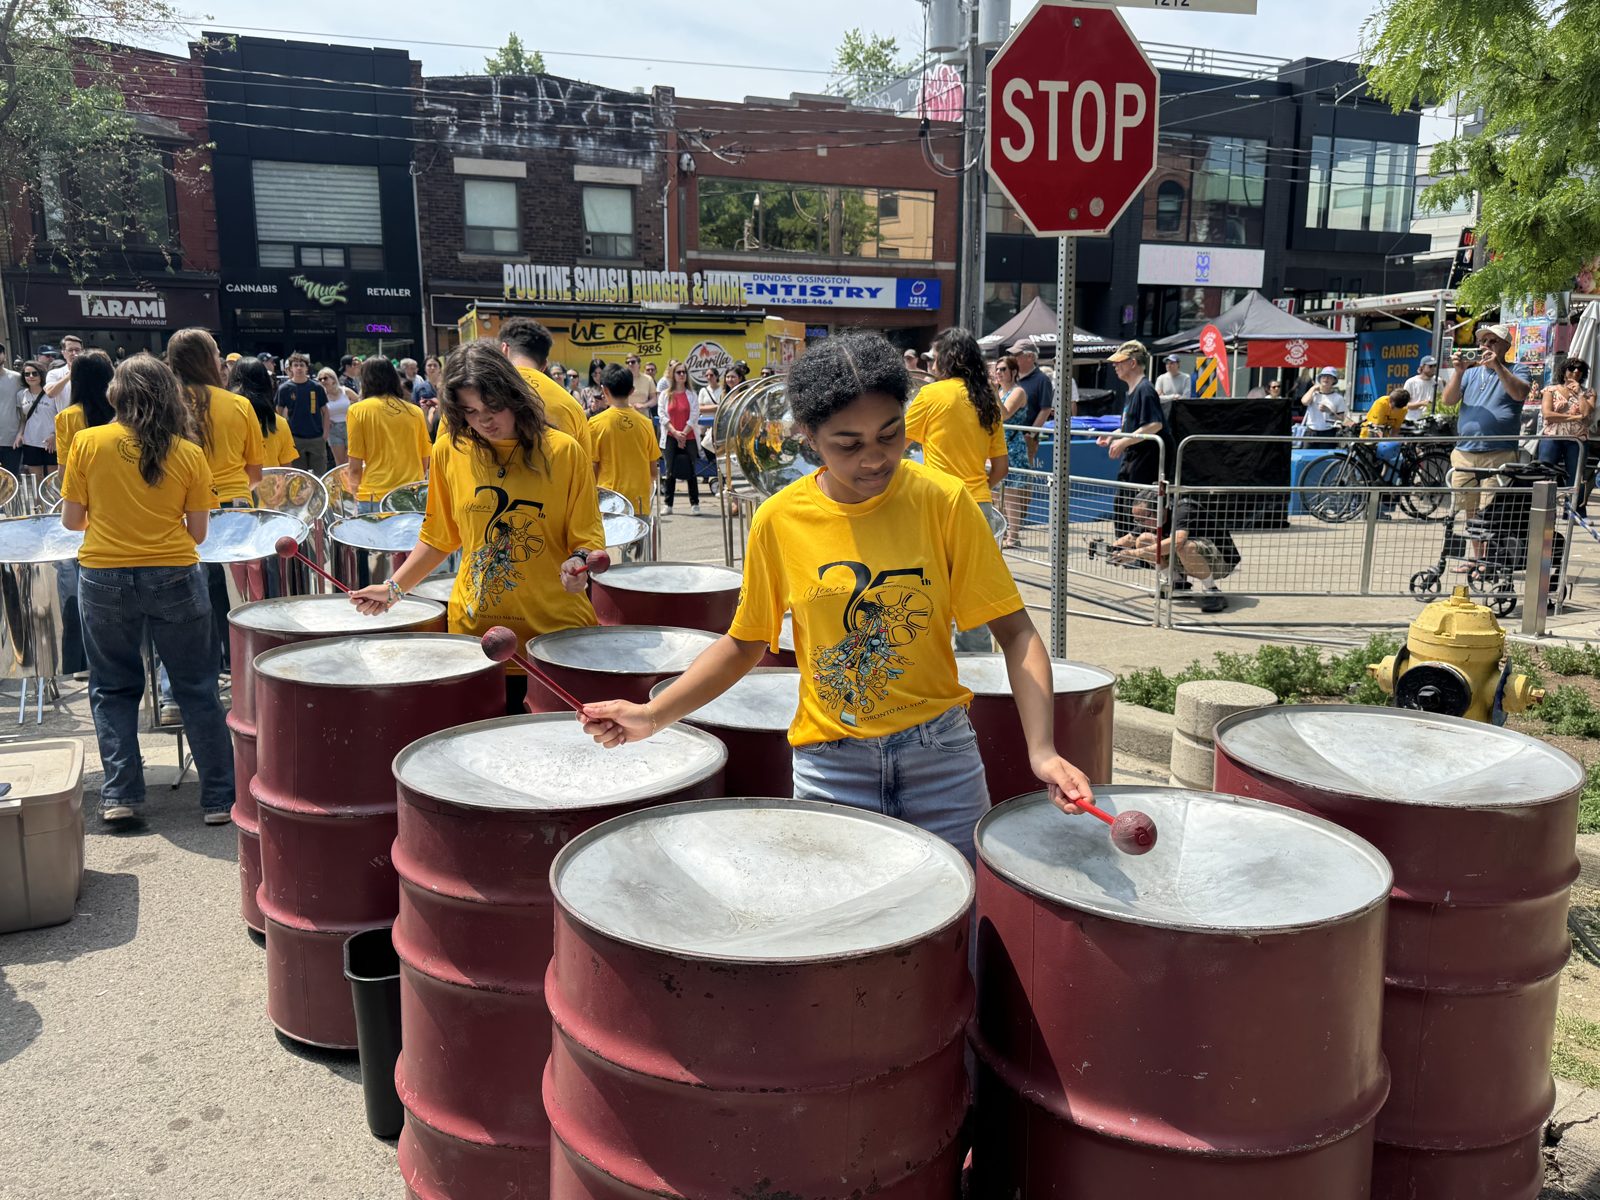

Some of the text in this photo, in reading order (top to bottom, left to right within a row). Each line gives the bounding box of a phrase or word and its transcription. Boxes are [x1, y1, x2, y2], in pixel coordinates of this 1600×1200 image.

[1000, 77, 1147, 163] STOP
[503, 263, 748, 307] POUTINE SMASH BURGER & MORE
[752, 273, 850, 284] DUNDAS OSSINGTON
[225, 283, 278, 293] CANNABIS
[304, 282, 347, 304] Nug
[367, 287, 411, 297] RETAILER
[743, 282, 883, 299] ENTISTRY
[68, 290, 166, 318] TARAMI
[770, 297, 833, 305] 416-588-4466
[909, 296, 928, 304] 1217
[131, 317, 167, 325] Menswear
[571, 321, 665, 342] WE CATER
[637, 342, 663, 356] 1986
[1381, 344, 1419, 359] GAMES
[1387, 364, 1409, 377] FOR
[804, 585, 847, 602] Years
[860, 708, 895, 722] TORONTO
